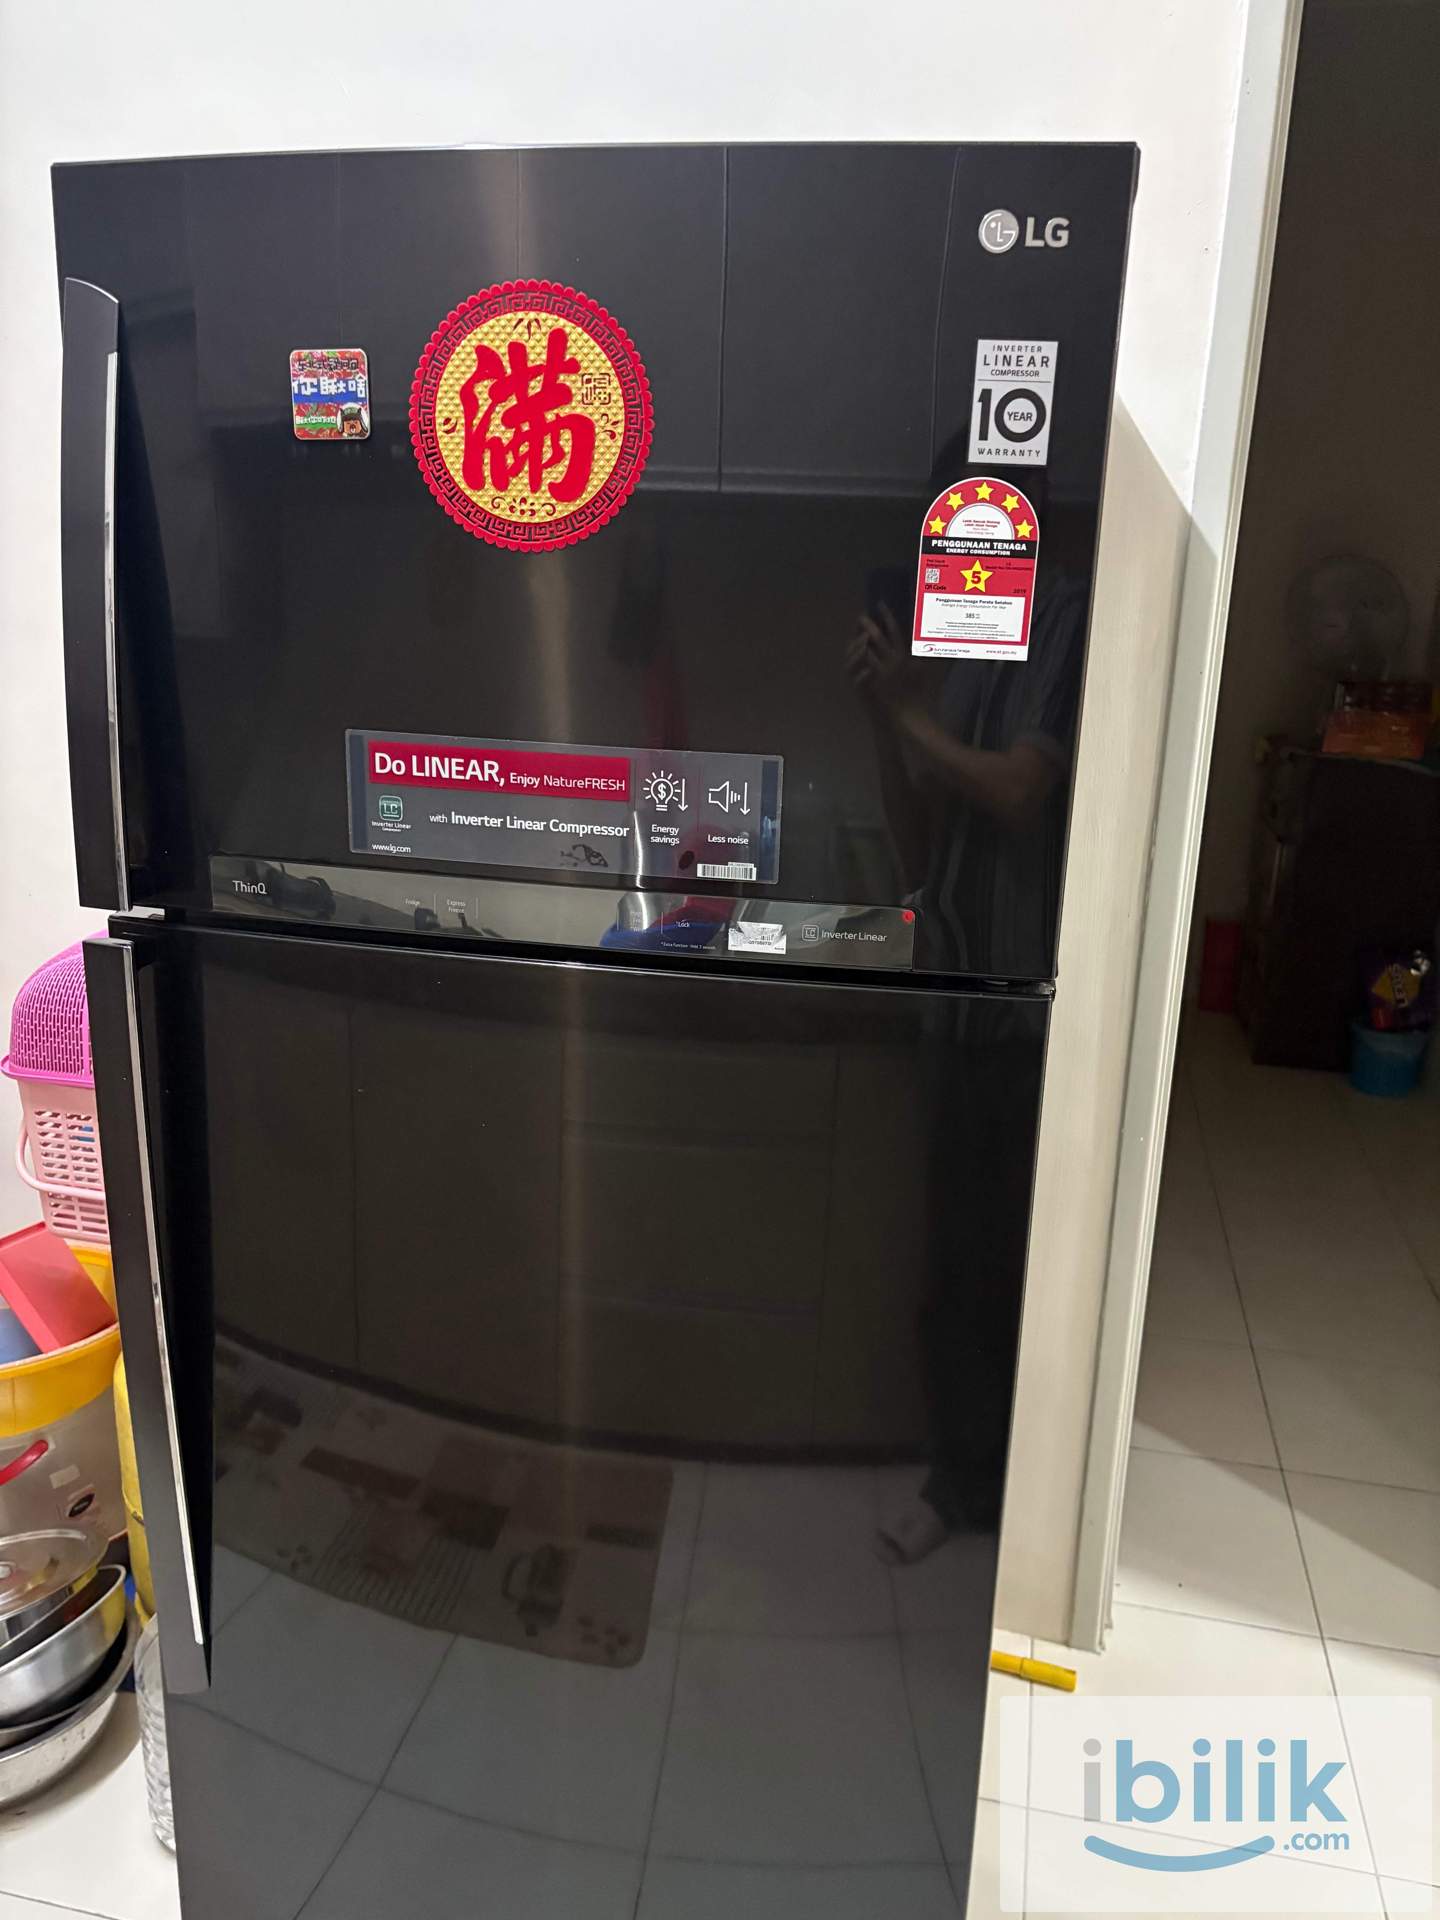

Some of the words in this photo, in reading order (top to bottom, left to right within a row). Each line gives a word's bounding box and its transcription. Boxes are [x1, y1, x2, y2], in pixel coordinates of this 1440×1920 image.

[1025, 216, 1070, 248] LG
[992, 344, 1043, 353] INVERTER
[983, 354, 1050, 368] LINEAR
[990, 369, 1040, 378] COMPRESSOR
[978, 387, 1047, 443] 10
[1007, 412, 1033, 422] YEAR
[977, 448, 1041, 457] WARRANTY
[931, 539, 991, 550] PENGGUNAAN
[992, 542, 1027, 551] TENAGA
[971, 571, 982, 585] 5
[374, 752, 406, 776] Do
[411, 754, 505, 787] LINEAR,
[509, 772, 540, 788] Enjoy
[543, 774, 626, 791] NatureFRESH
[429, 814, 448, 824] with
[451, 811, 503, 828] Inverter
[506, 816, 547, 831] Linear
[549, 819, 630, 837] Compressor
[651, 824, 680, 835] Energy
[650, 836, 680, 846] savings
[707, 834, 725, 843] Less
[727, 835, 749, 844] noise
[232, 880, 268, 895] ThinQ
[821, 930, 857, 940] Inverter
[858, 932, 888, 942] Linear
